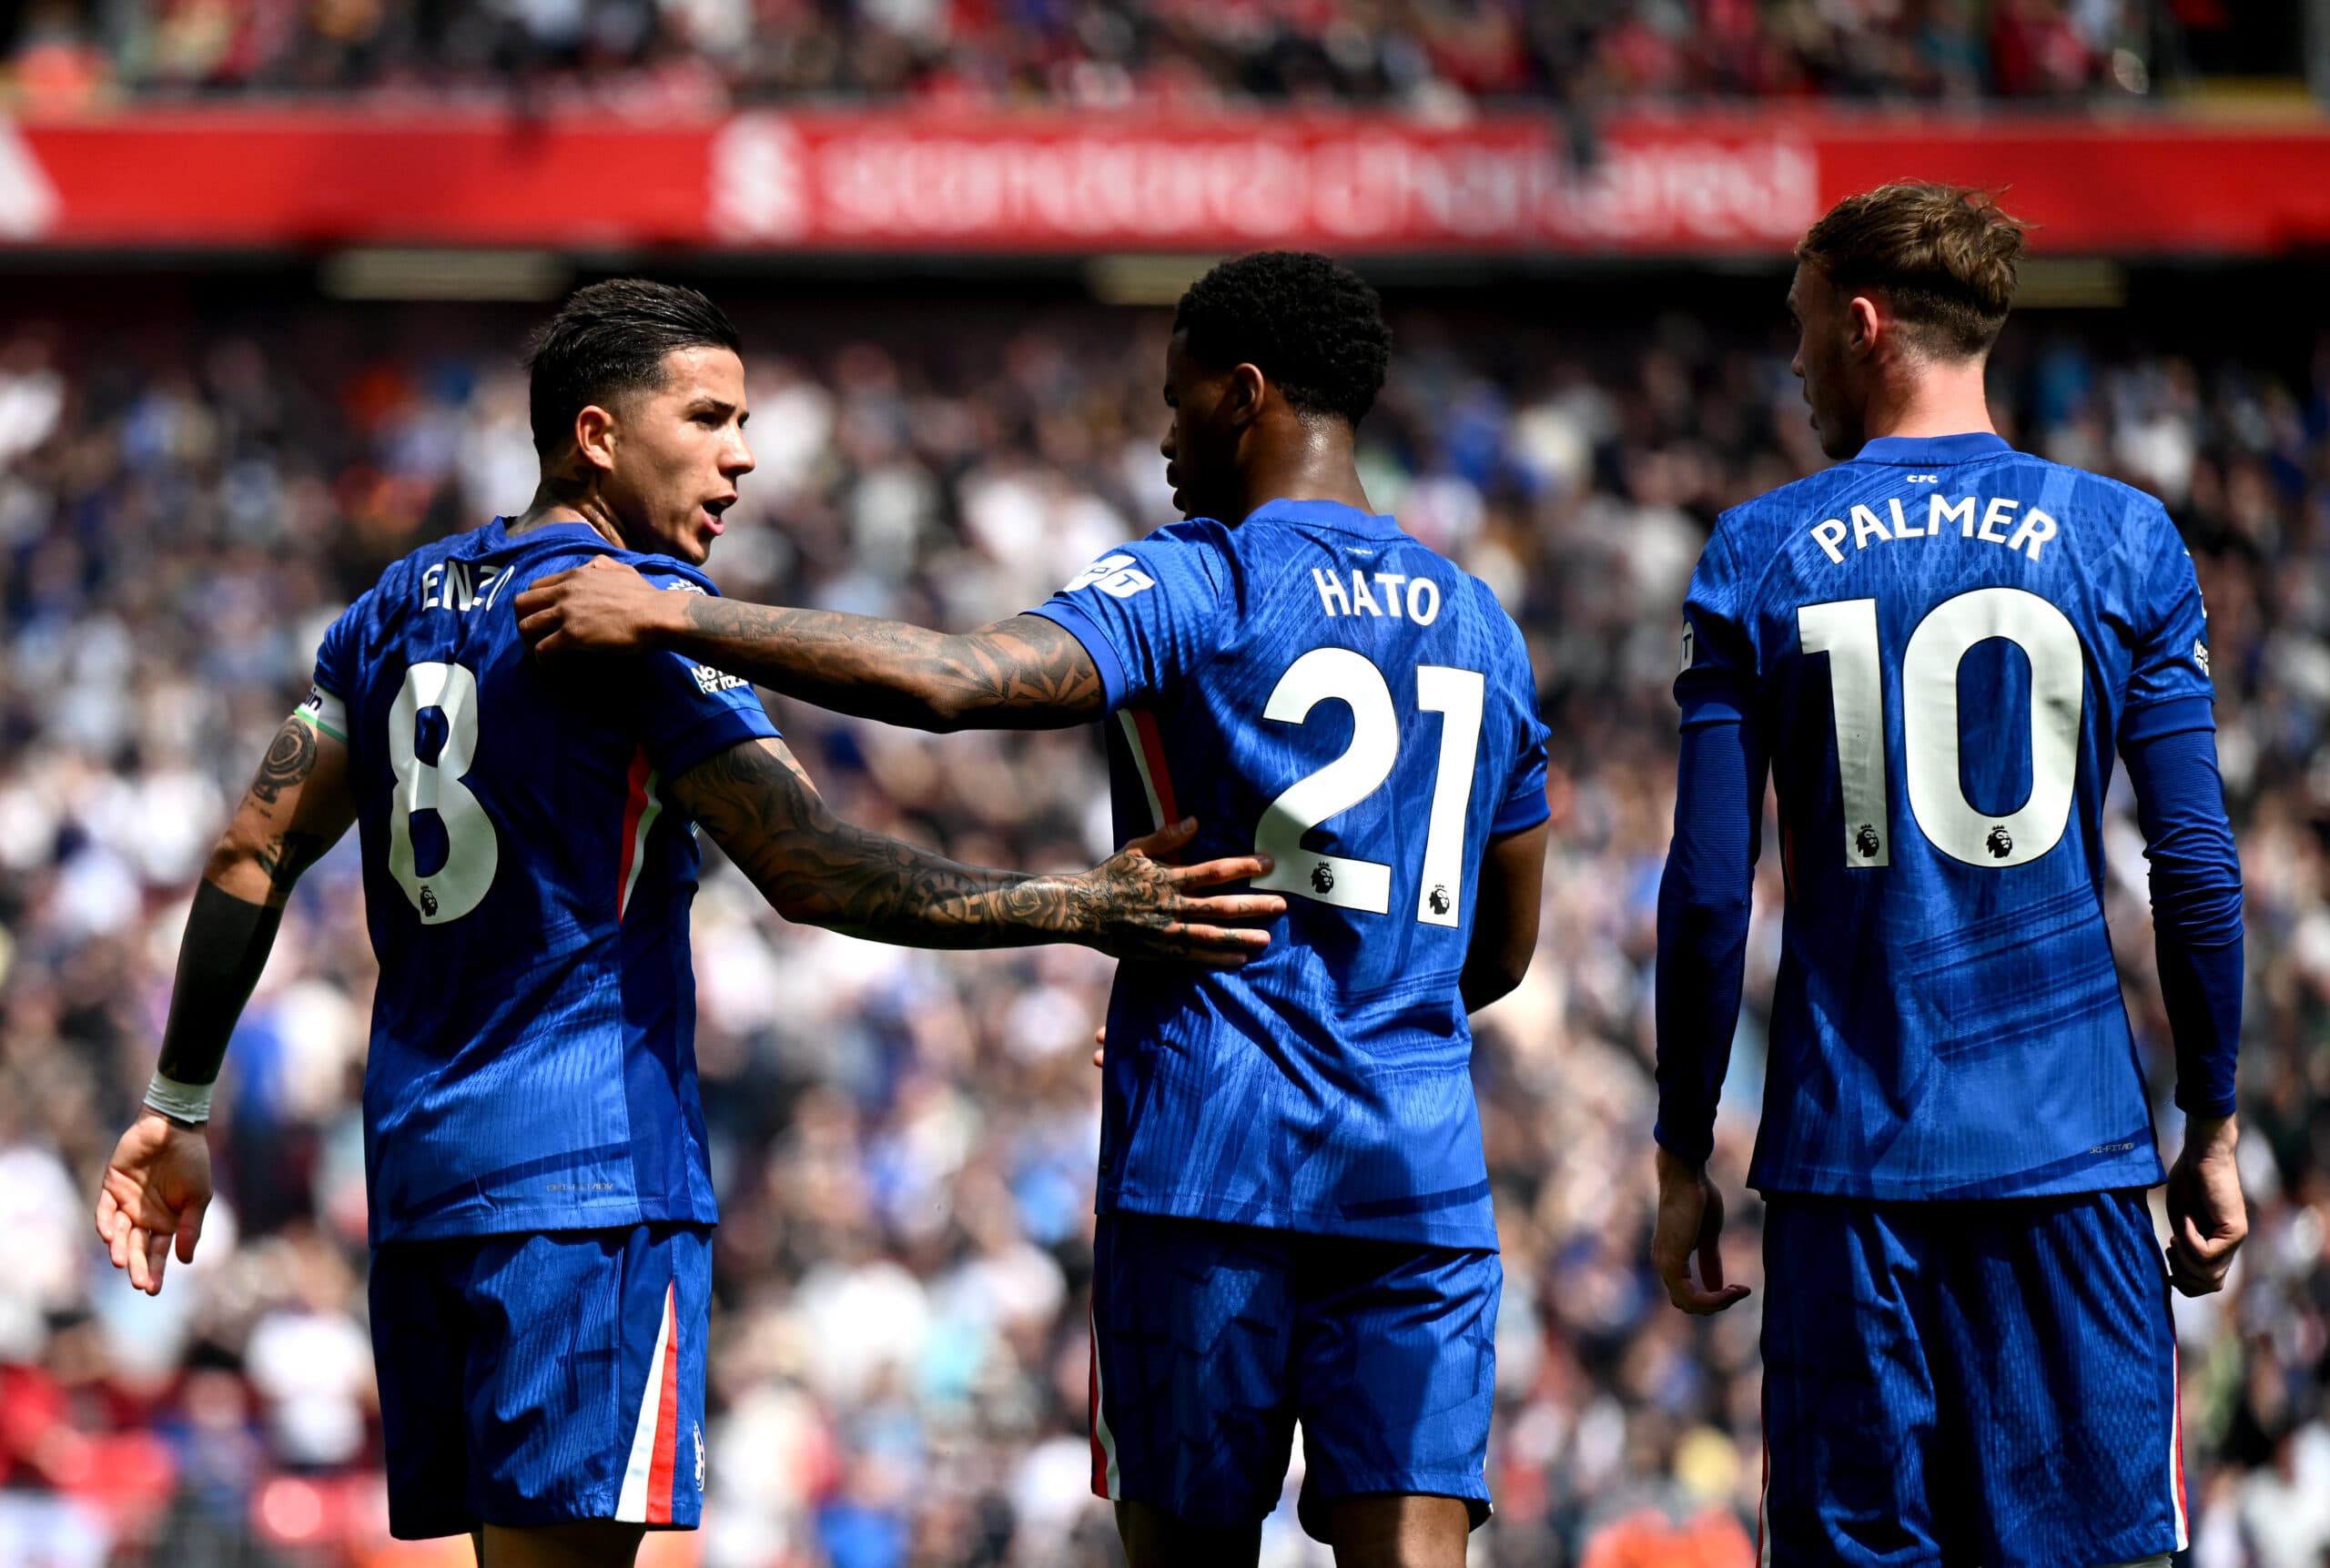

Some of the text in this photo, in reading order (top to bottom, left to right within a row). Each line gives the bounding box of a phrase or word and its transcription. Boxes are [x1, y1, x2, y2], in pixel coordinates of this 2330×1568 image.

[1809, 493, 2058, 565] PALMER
[1907, 474, 1939, 483] CFC
[1312, 568, 1441, 626] HATO
[389, 662, 498, 925] 8
[1250, 646, 1484, 929] 21
[1797, 587, 2084, 867] 10
